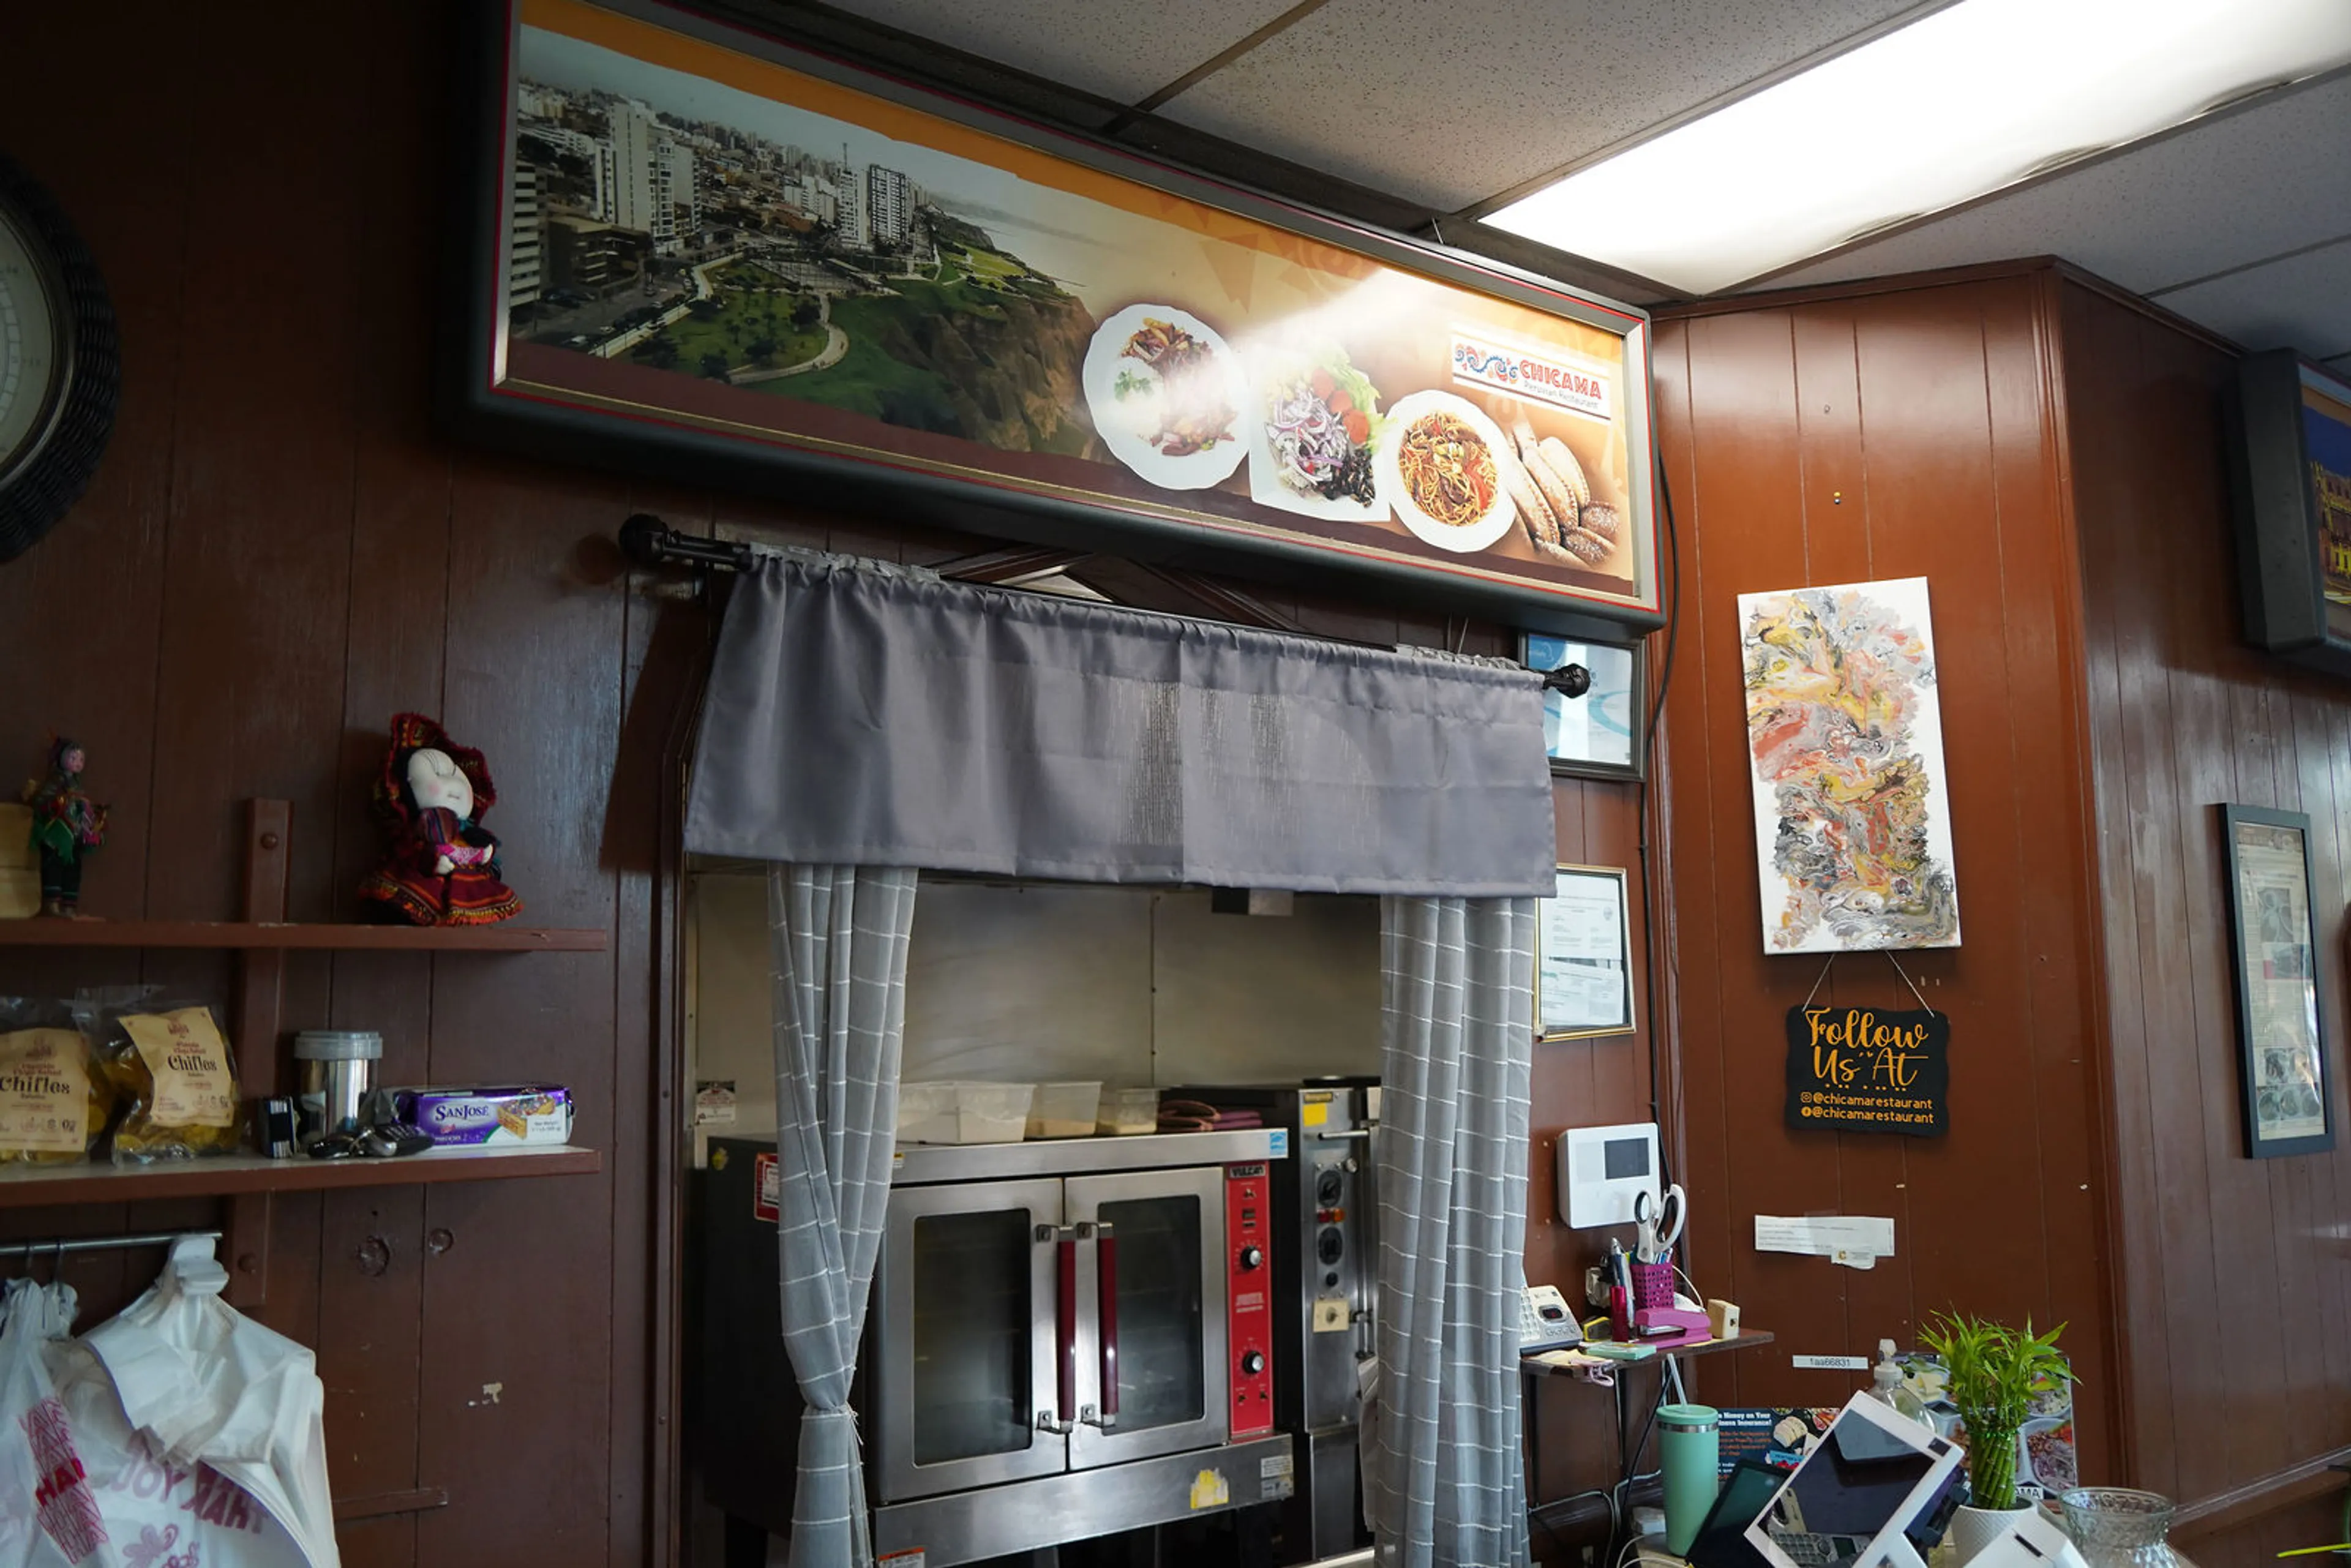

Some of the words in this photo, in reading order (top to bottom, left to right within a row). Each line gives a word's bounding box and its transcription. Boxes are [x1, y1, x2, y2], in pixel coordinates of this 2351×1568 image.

[1520, 359, 1602, 400] CHICAMA
[1805, 1007, 1929, 1048] Follow
[1813, 1045, 1861, 1084] Us
[1872, 1047, 1929, 1087] At
[1812, 1106, 1933, 1123] @chicamarestaurant
[1813, 1092, 1932, 1109] @chicamarestaurant
